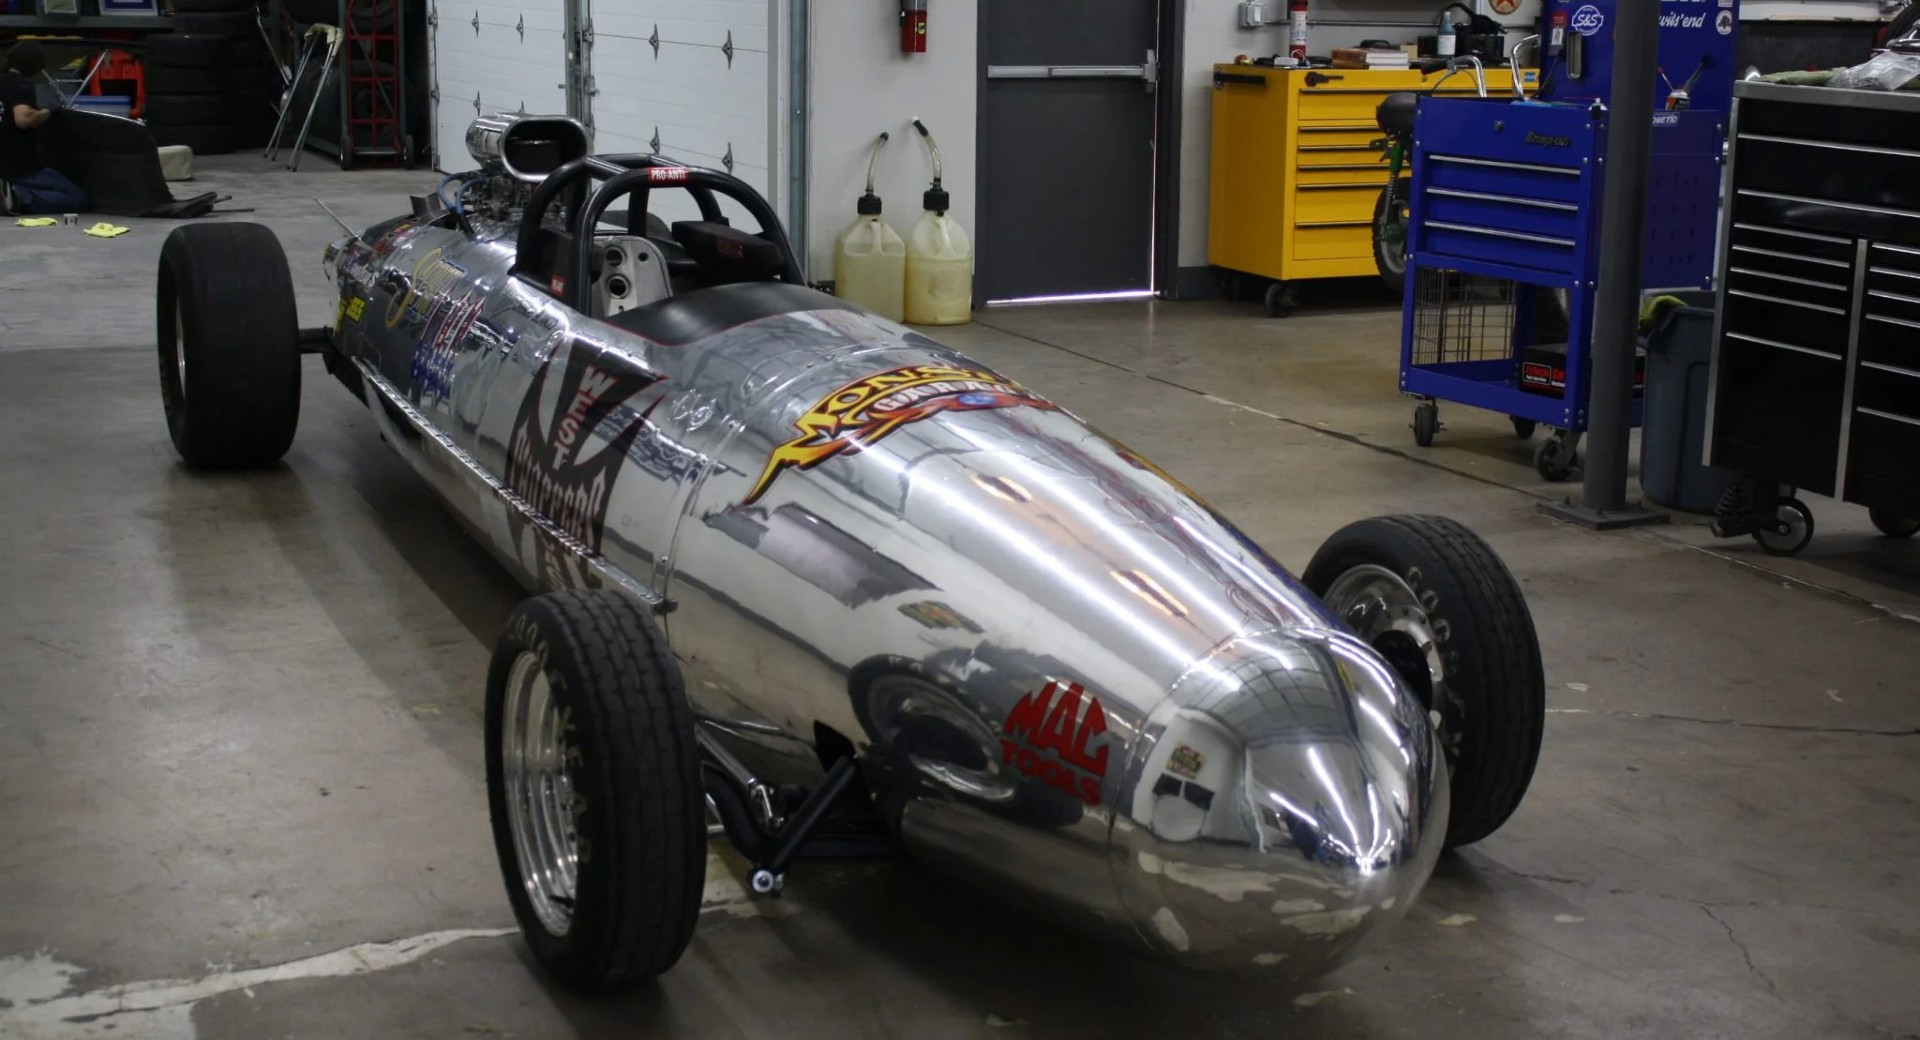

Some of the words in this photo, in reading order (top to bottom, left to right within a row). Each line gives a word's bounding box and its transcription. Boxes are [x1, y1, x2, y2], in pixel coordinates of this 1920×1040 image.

[1577, 14, 1599, 27] S&S
[553, 366, 617, 471] WEST
[1003, 681, 1108, 776] MAC
[1000, 739, 1102, 806] TOOLS
